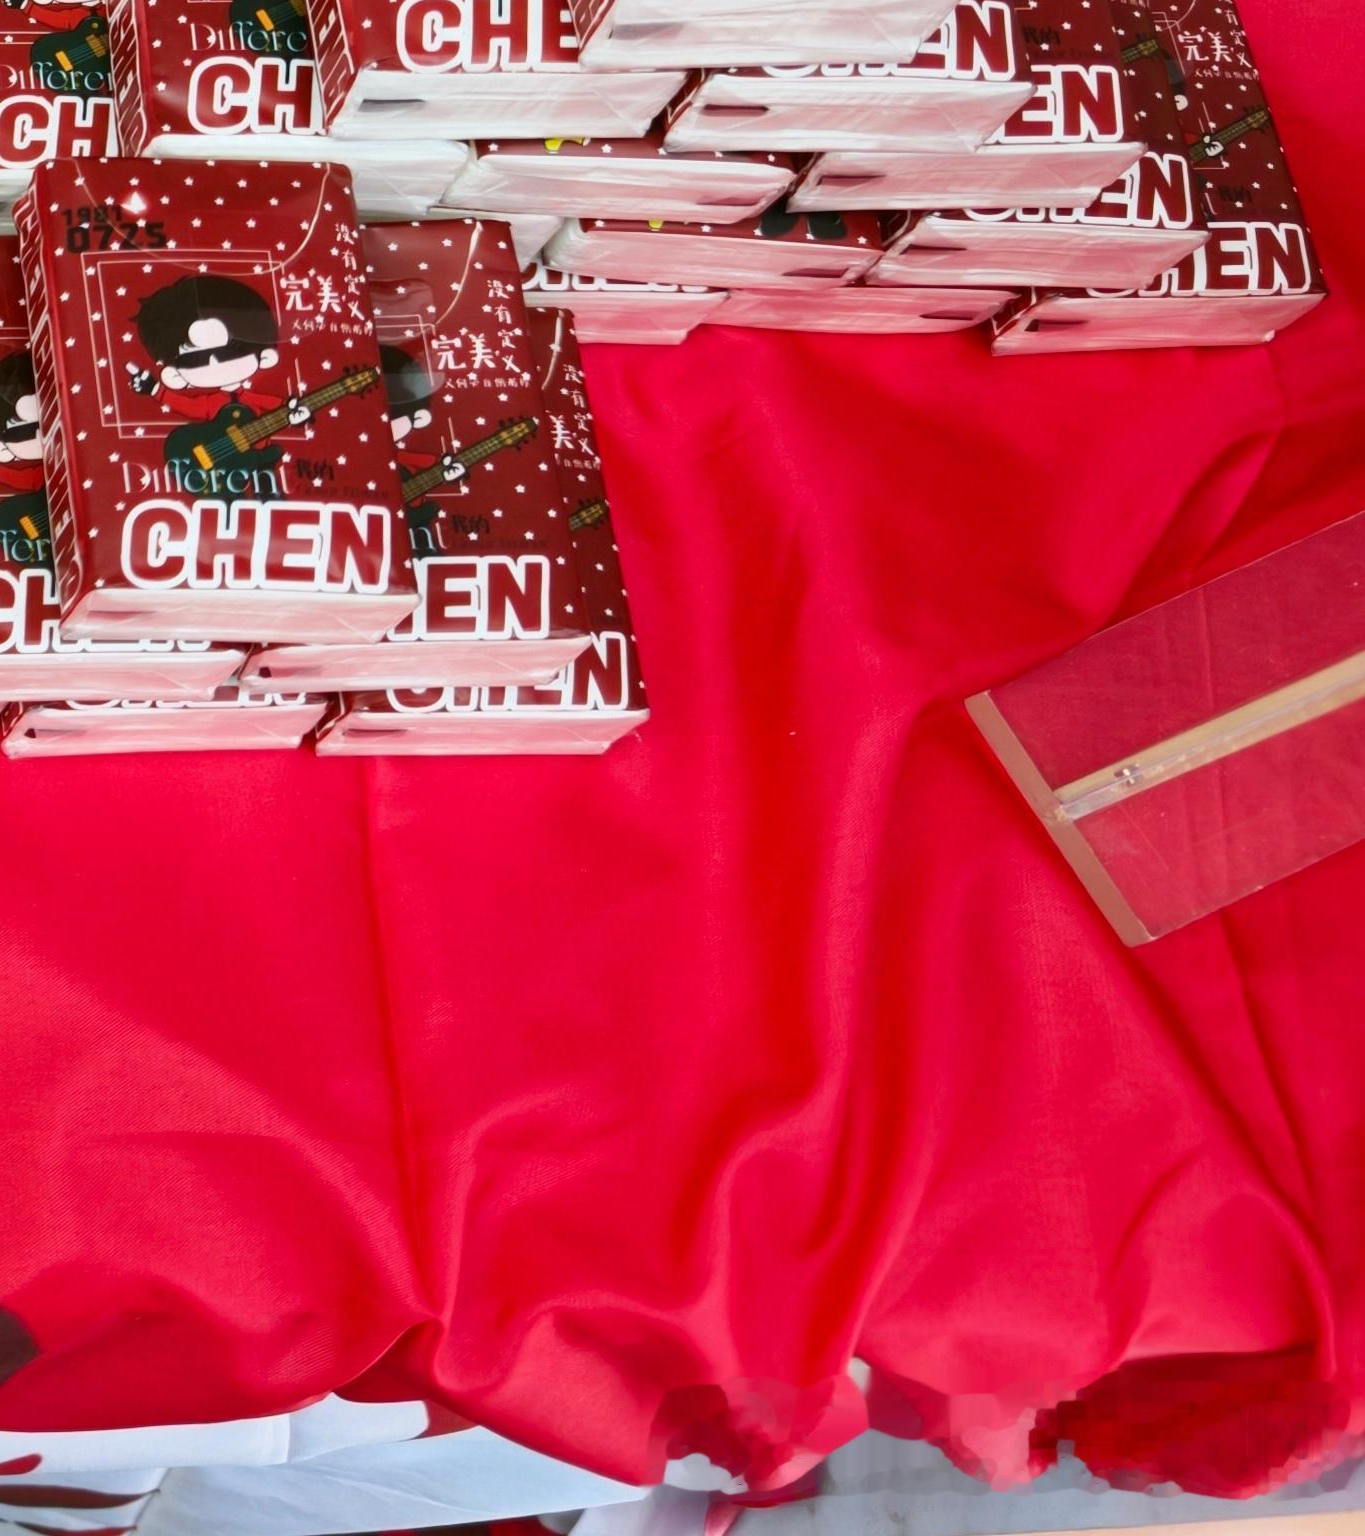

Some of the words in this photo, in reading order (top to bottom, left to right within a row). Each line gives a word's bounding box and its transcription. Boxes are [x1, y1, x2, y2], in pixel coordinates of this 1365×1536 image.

[187, 57, 328, 136] CH
[66, 222, 168, 254] 0725
[280, 275, 343, 314] 完美
[432, 333, 497, 370] 完美
[122, 458, 292, 495] Different
[122, 499, 392, 595] CHEN
